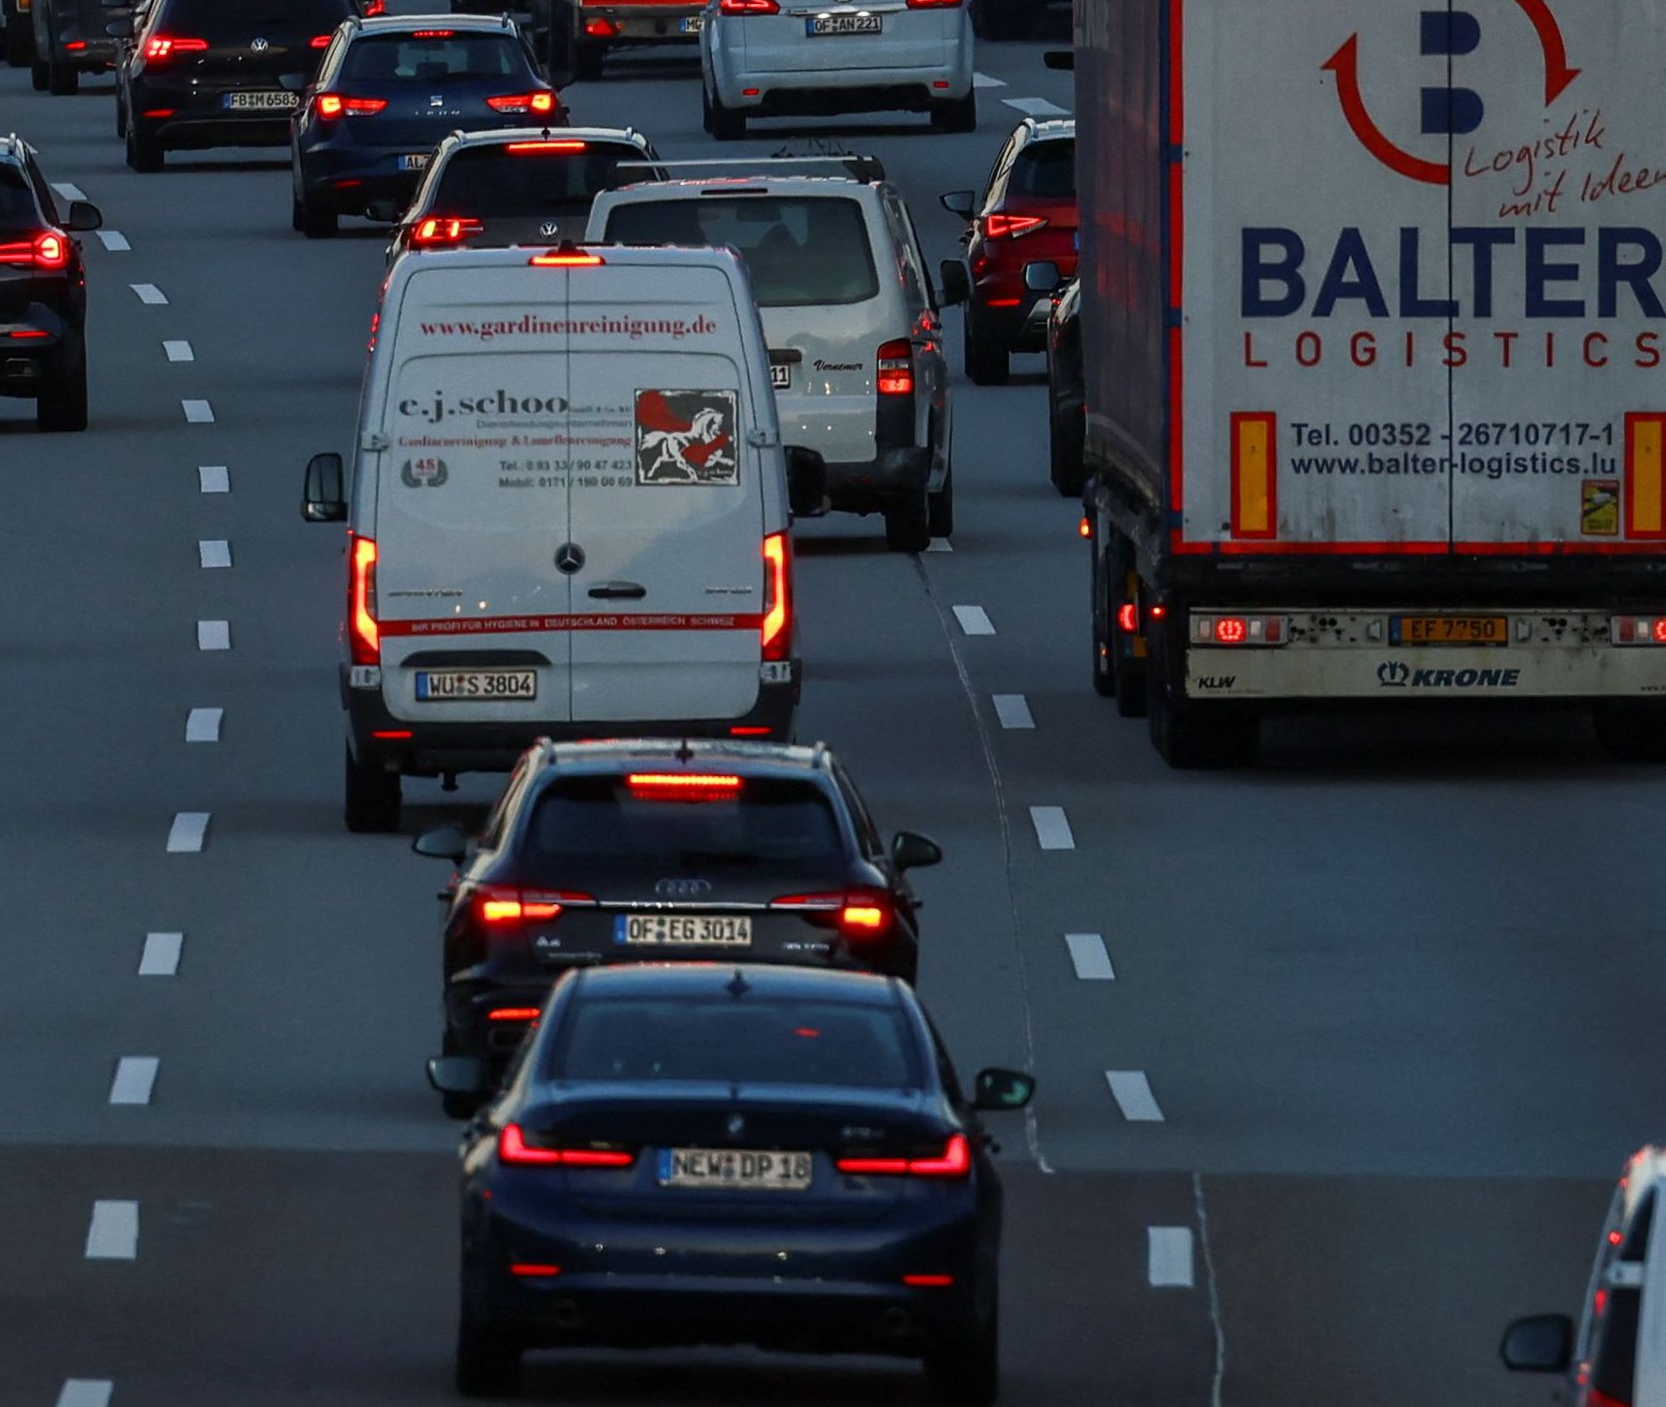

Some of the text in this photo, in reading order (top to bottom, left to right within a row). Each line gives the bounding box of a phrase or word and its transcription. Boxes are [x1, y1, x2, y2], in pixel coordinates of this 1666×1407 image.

[815, 18, 879, 33] OF AN 221
[230, 95, 247, 107] FB
[1463, 108, 1606, 197] Logistik
[1498, 169, 1567, 218] mit
[419, 315, 717, 341] www.gardinenreinigung.de
[1244, 331, 1663, 368] LOGISTICS
[1290, 422, 1340, 447] Tel.
[1349, 422, 1431, 447] 00352
[1458, 422, 1614, 446] 26710717-1
[415, 458, 436, 471] 45
[1290, 452, 1617, 480] www.balter-logistics.lu
[484, 618, 528, 630] HYGIENE
[544, 616, 618, 628] DEUTSCHLAND
[690, 615, 735, 627] SCHWEIZ
[1411, 619, 1437, 639] EF
[467, 675, 480, 694] S
[483, 674, 532, 694] 3804
[1197, 675, 1236, 690] KLW
[1410, 667, 1521, 688] KRONE
[629, 918, 748, 941] OF EG 3014
[740, 1153, 773, 1178] DP
